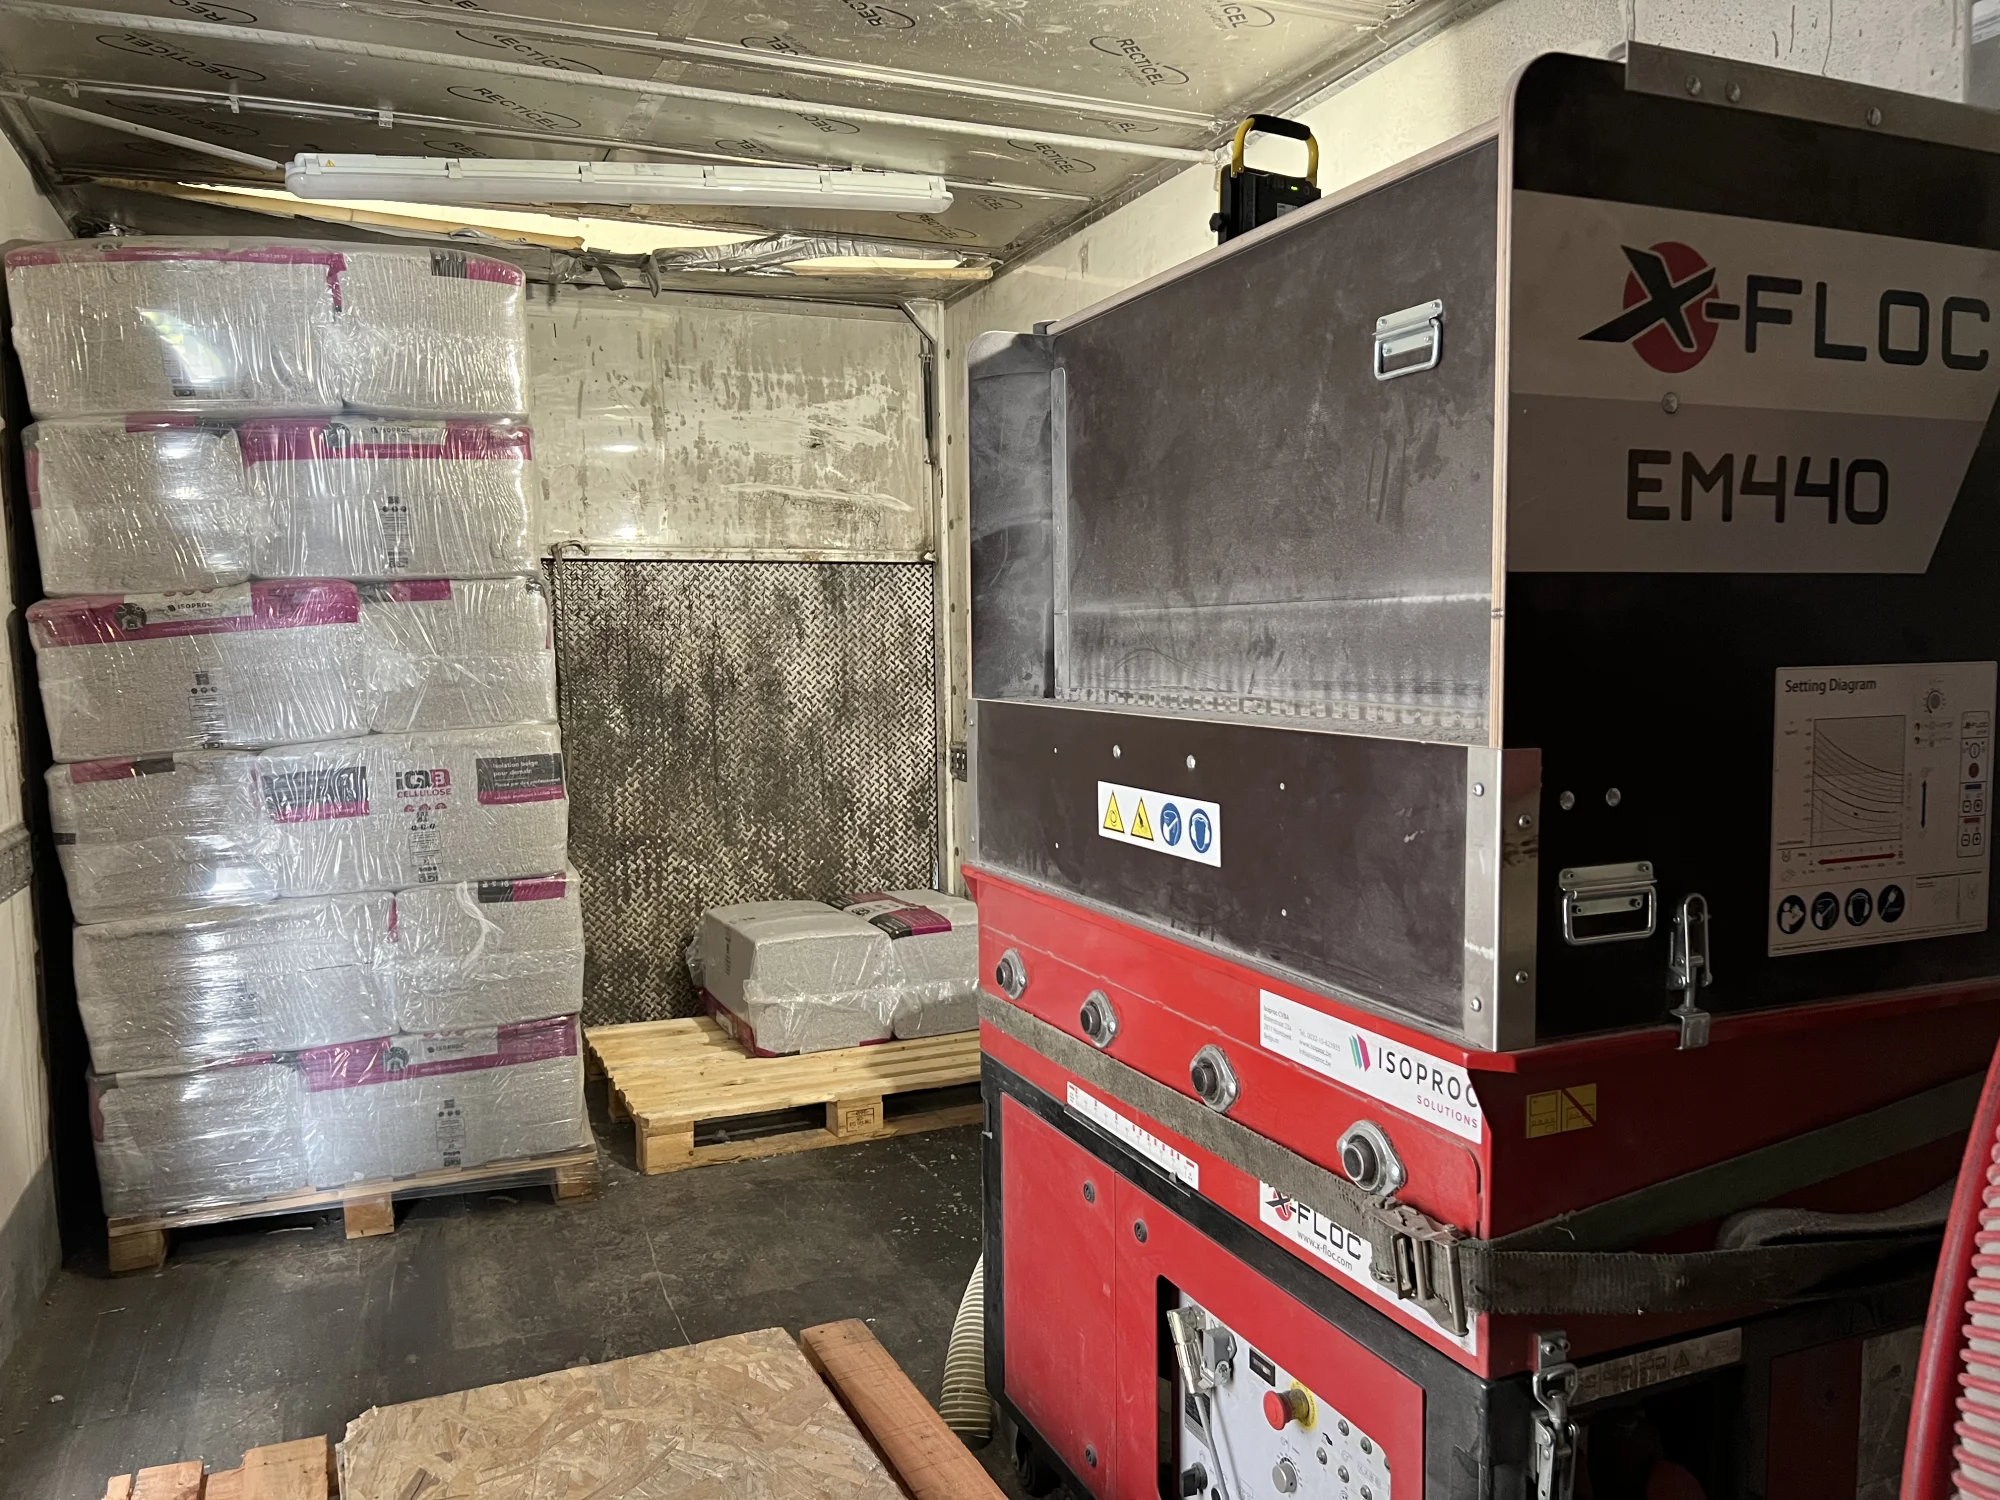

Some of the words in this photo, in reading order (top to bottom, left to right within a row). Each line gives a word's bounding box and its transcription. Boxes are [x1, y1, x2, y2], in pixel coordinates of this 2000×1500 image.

[123, 33, 241, 81] RECTICEL
[1116, 38, 1163, 86] RECTICEL
[473, 87, 560, 130] RECTICEL
[1578, 244, 1991, 371] X-FLOC
[1626, 449, 1889, 525] EM440
[177, 601, 213, 610] ISOPROC
[1785, 679, 1826, 695] Setting
[1828, 678, 1877, 693] Diagram
[397, 788, 453, 798] CELLULOSE
[1378, 1047, 1480, 1108] ISOPROC
[1416, 1094, 1479, 1130] SOLUTIONS
[1265, 1190, 1362, 1261] X-FLOC
[1297, 1230, 1354, 1271] www.x-floc.com
